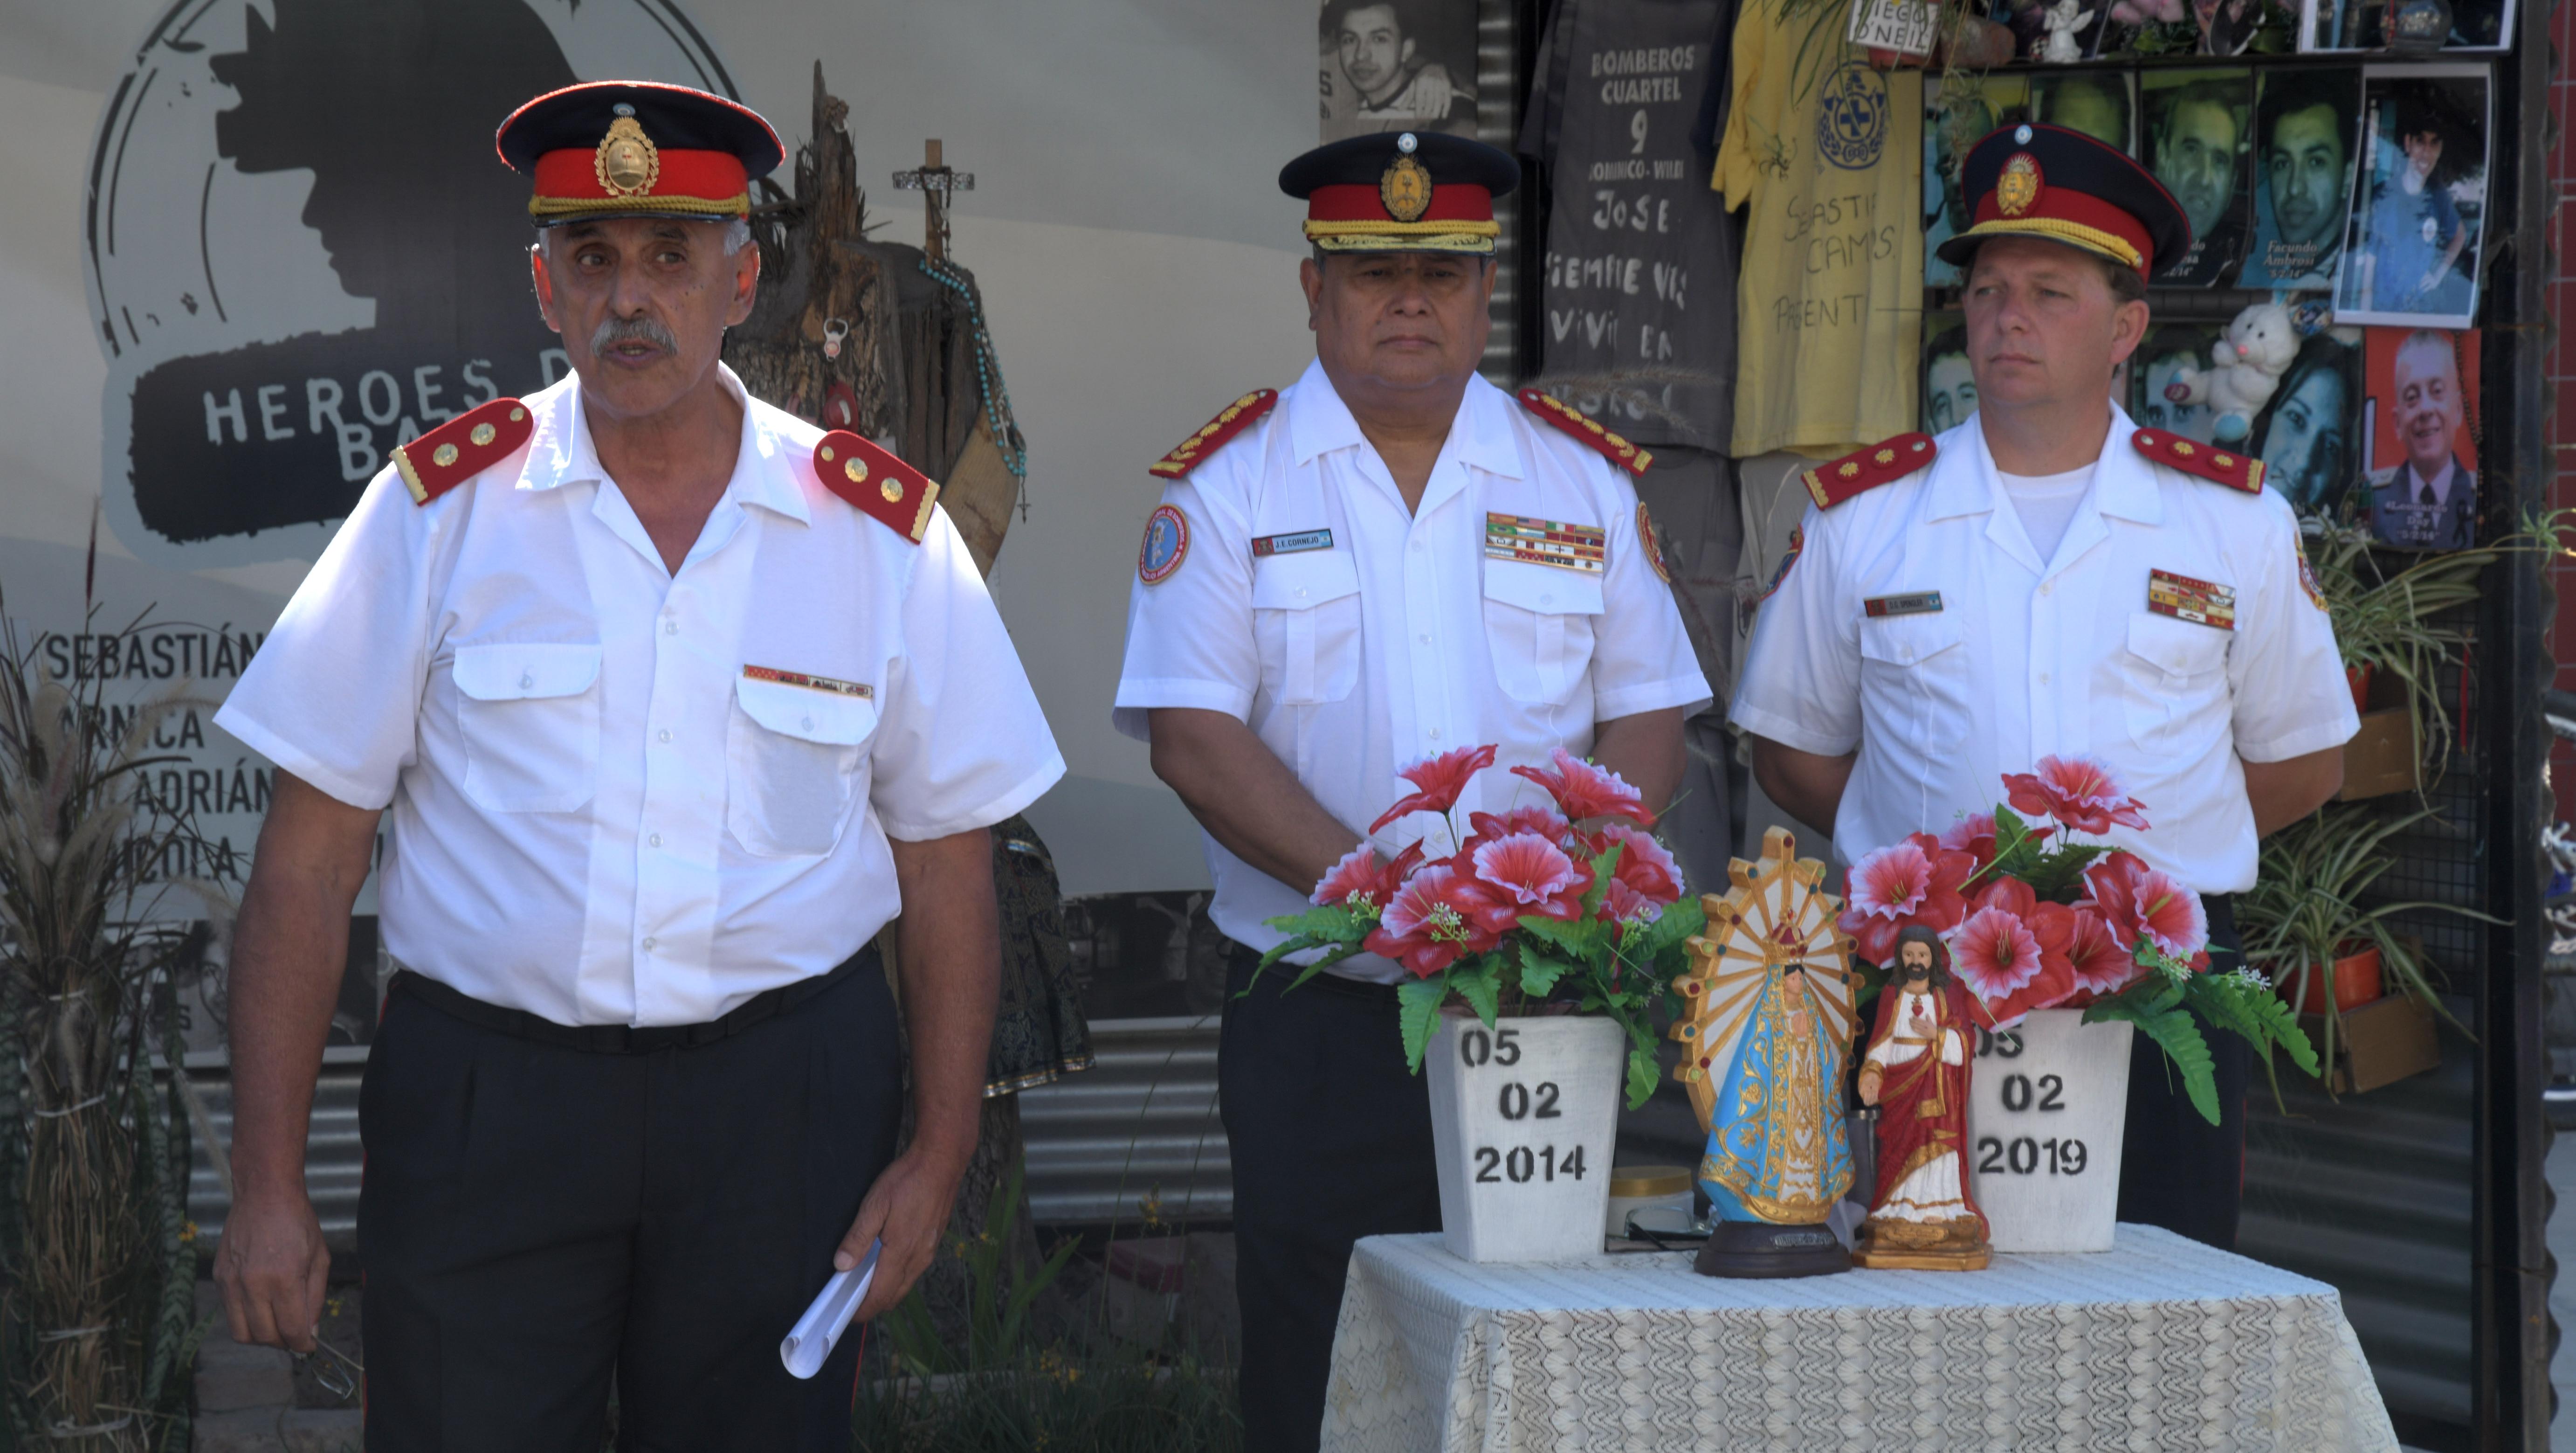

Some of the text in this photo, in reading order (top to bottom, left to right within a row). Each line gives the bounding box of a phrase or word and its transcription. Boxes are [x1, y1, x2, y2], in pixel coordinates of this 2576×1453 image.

[1858, 0, 1925, 23] IEGO
[1591, 44, 1695, 78] BOMBEROS
[1601, 76, 1682, 105] CUARTEL
[1631, 108, 1649, 155] 9
[2263, 253, 2316, 266] Ambrosi
[2266, 239, 2318, 253] Facundo
[203, 360, 499, 445] HEROES
[2407, 515, 2430, 527] Day
[46, 623, 264, 679] SEBASTIÁN
[134, 757, 276, 814] ADRIÁN
[1460, 1029, 1521, 1067] 05
[1499, 1081, 1561, 1121] 02
[2001, 1074, 2065, 1113] 02
[1474, 1145, 1587, 1183] 2014
[1977, 1137, 2088, 1176] 2019
